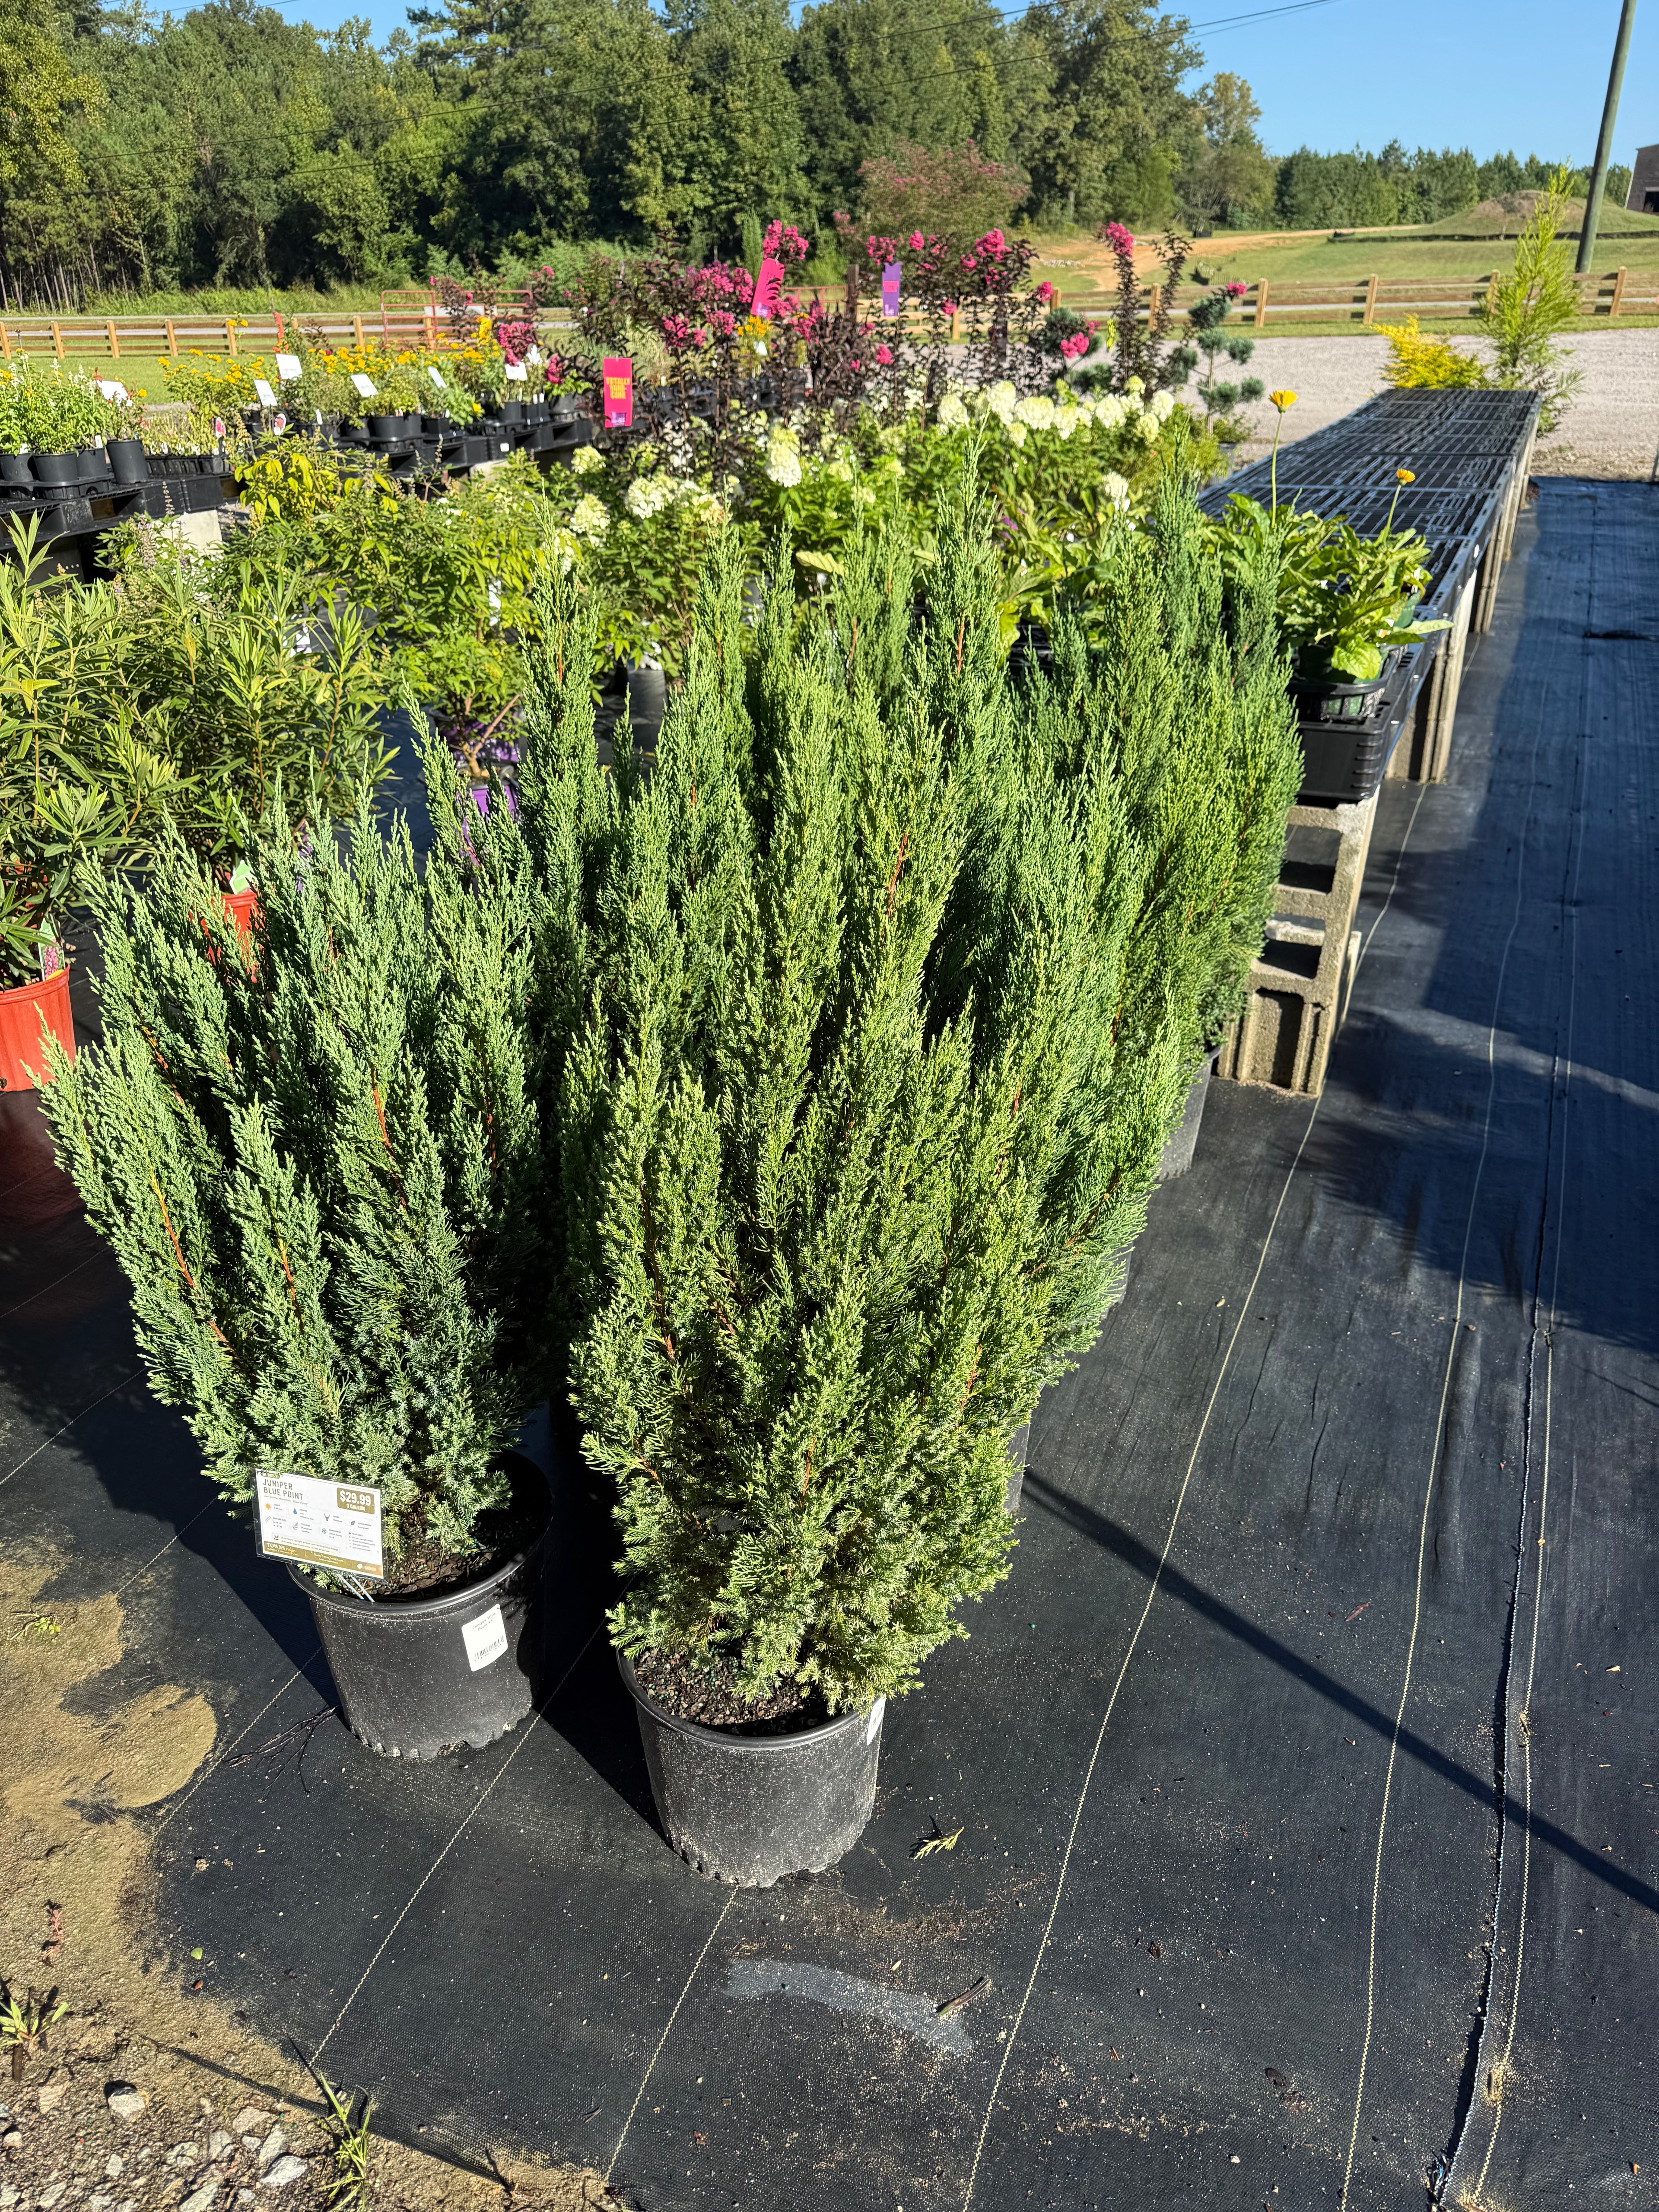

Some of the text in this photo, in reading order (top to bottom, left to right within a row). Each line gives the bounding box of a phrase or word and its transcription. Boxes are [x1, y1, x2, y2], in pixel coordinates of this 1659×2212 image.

[263, 1479, 293, 1490] JUNIPER
[264, 1487, 303, 1500] BLUE POINT
[340, 1490, 371, 1506] $29.99
